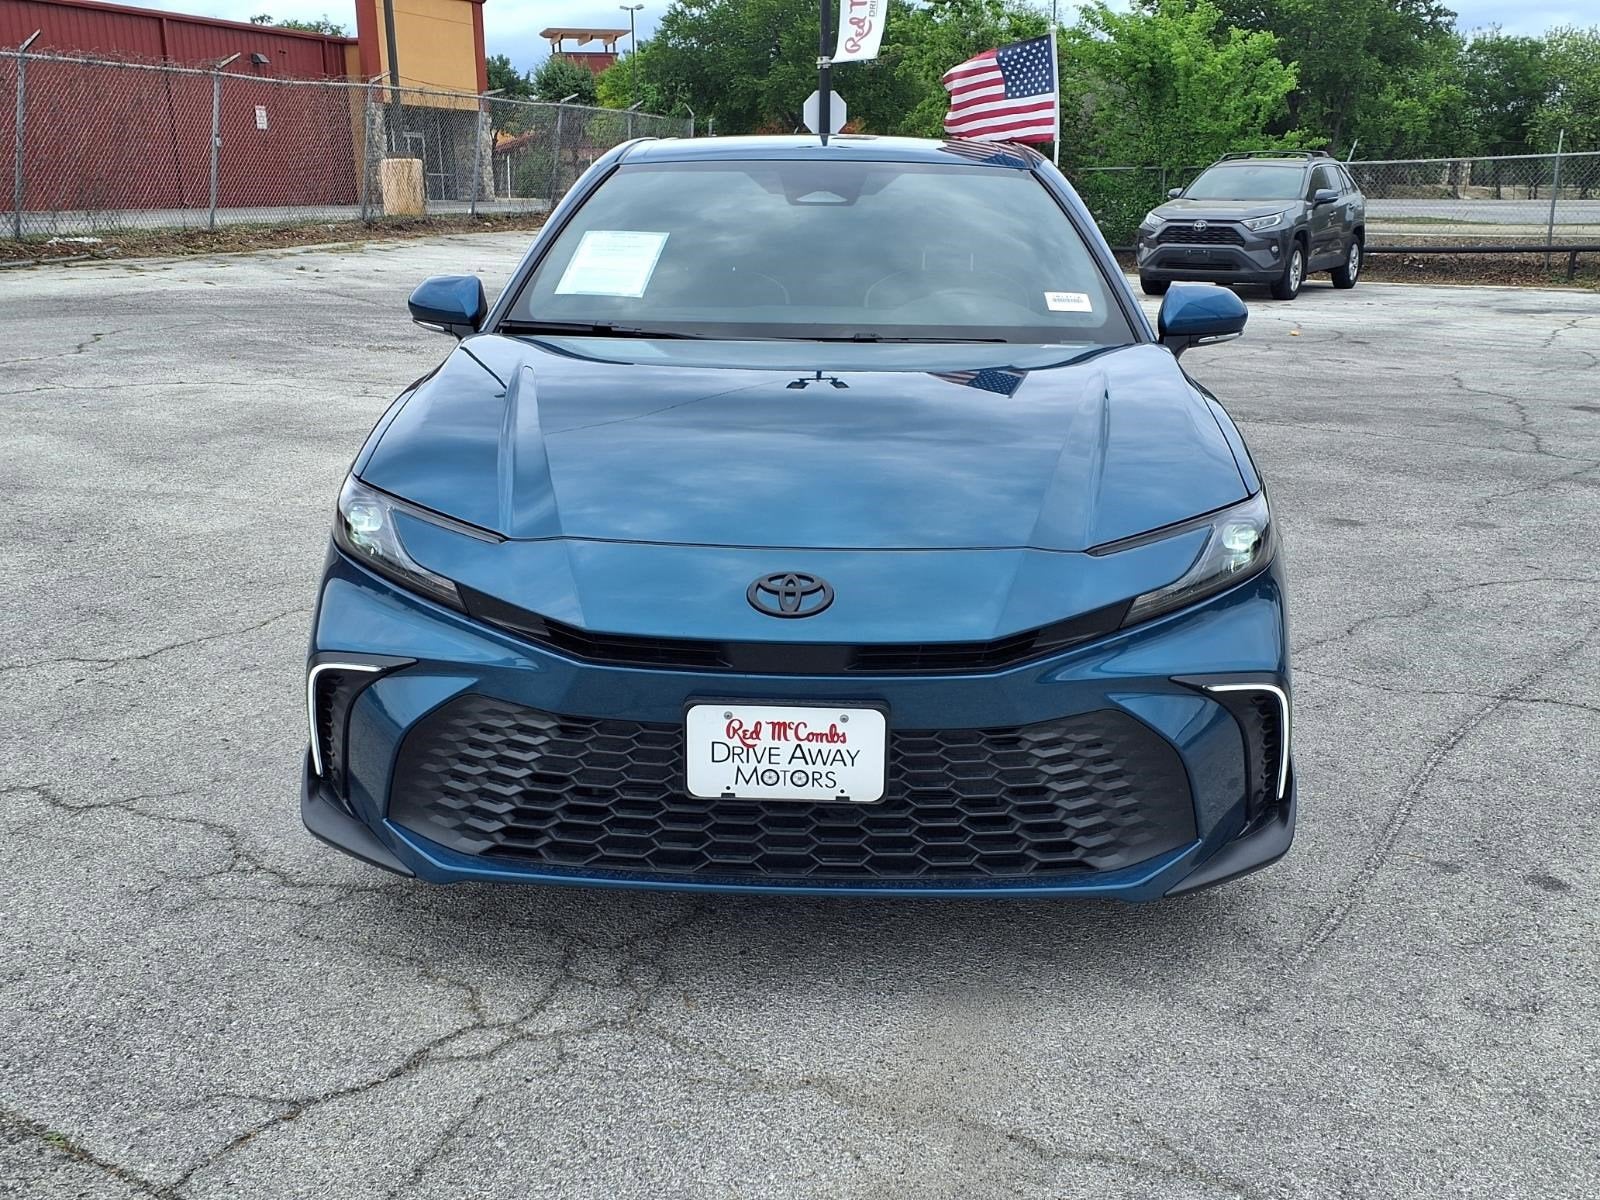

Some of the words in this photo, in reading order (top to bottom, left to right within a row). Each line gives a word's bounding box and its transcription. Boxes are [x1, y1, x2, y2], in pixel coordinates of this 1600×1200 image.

[845, 16, 872, 54] Red
[726, 719, 762, 749] Red
[766, 721, 847, 744] McCombs
[711, 741, 780, 764] DRIVE
[788, 743, 860, 767] AWAY
[734, 766, 837, 788] MOTORS
